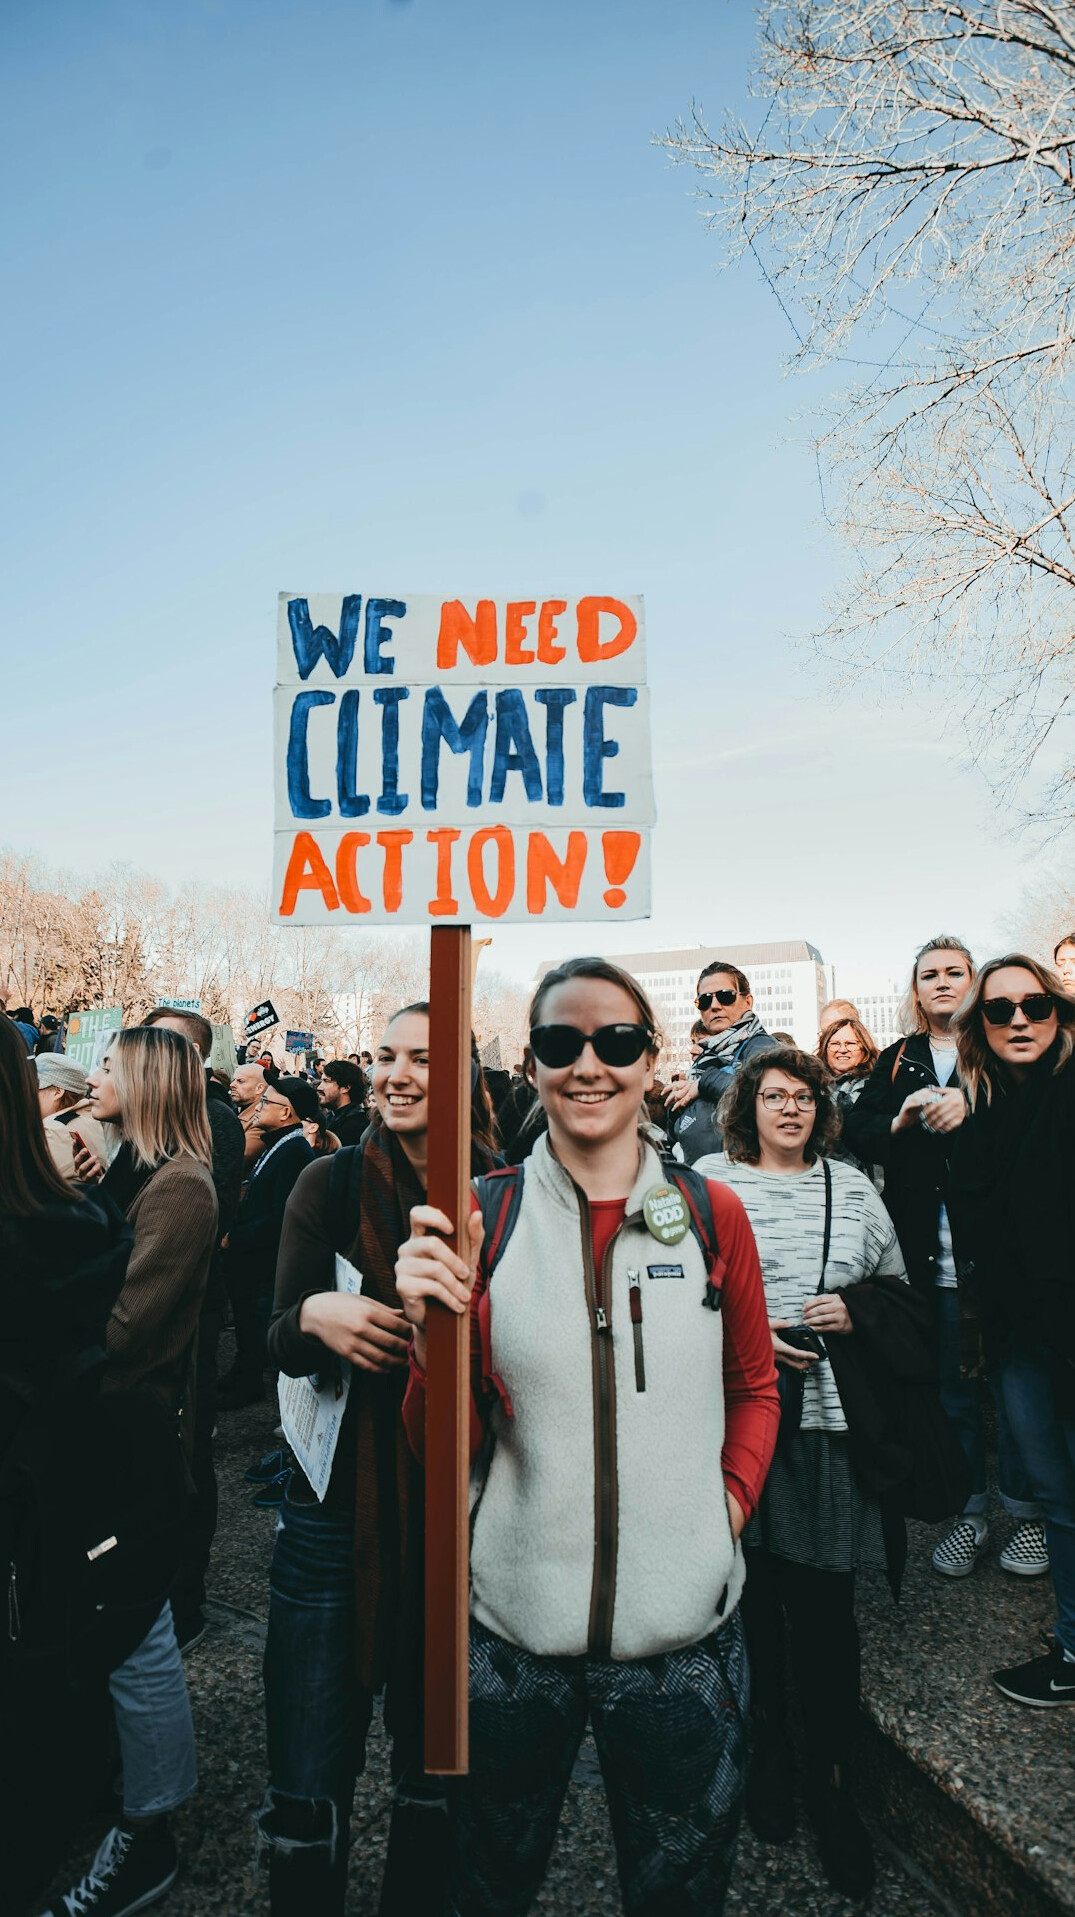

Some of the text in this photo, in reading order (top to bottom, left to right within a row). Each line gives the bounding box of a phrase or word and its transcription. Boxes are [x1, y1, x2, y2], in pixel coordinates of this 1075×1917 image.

[287, 594, 638, 680] WE NEED
[286, 685, 638, 819] CLIMATE
[279, 825, 641, 918] ACTION!
[81, 1013, 111, 1038] THE
[246, 1014, 275, 1034] ENERGY
[652, 1205, 684, 1227] ODD
